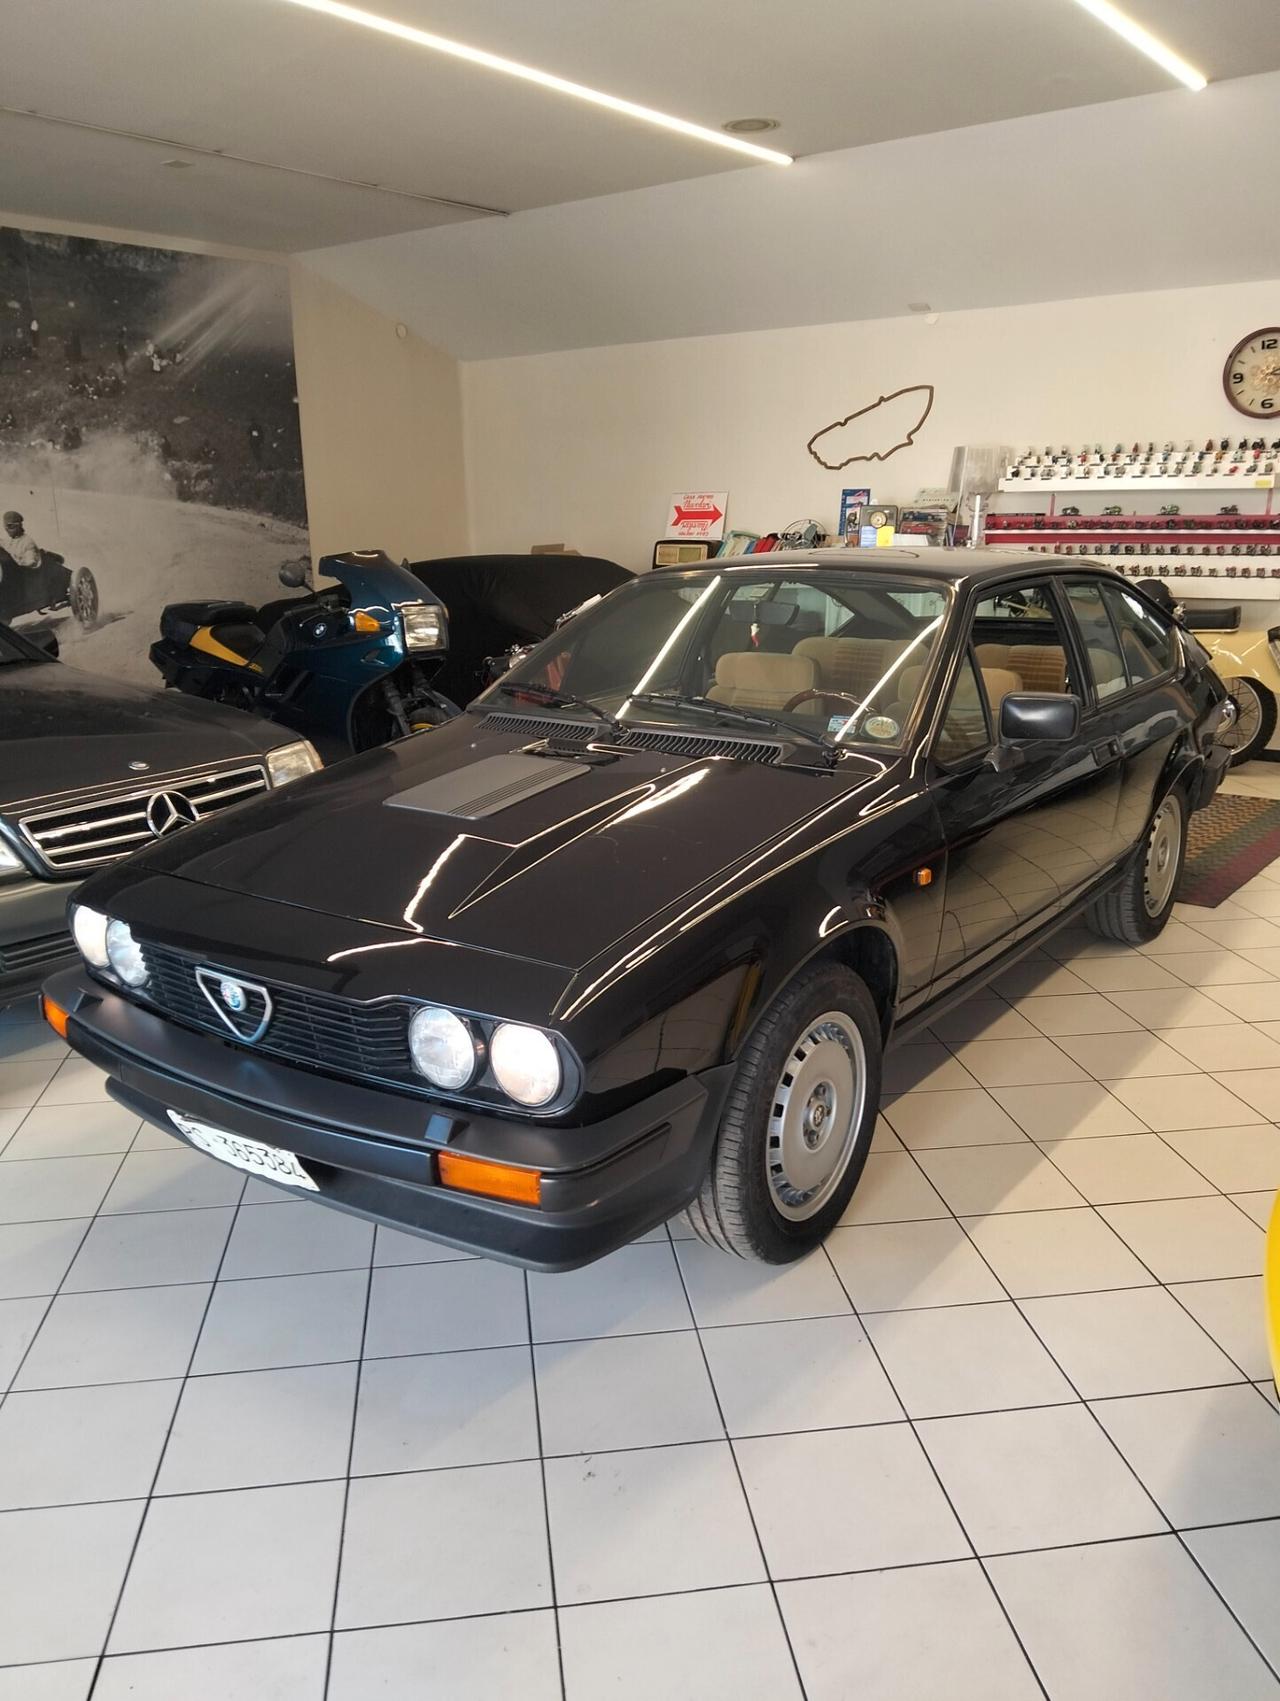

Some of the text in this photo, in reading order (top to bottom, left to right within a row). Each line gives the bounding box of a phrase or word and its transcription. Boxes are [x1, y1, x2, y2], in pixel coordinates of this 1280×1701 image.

[1261, 339, 1278, 350] 12
[1232, 373, 1244, 384] 9
[1261, 398, 1274, 409] 6
